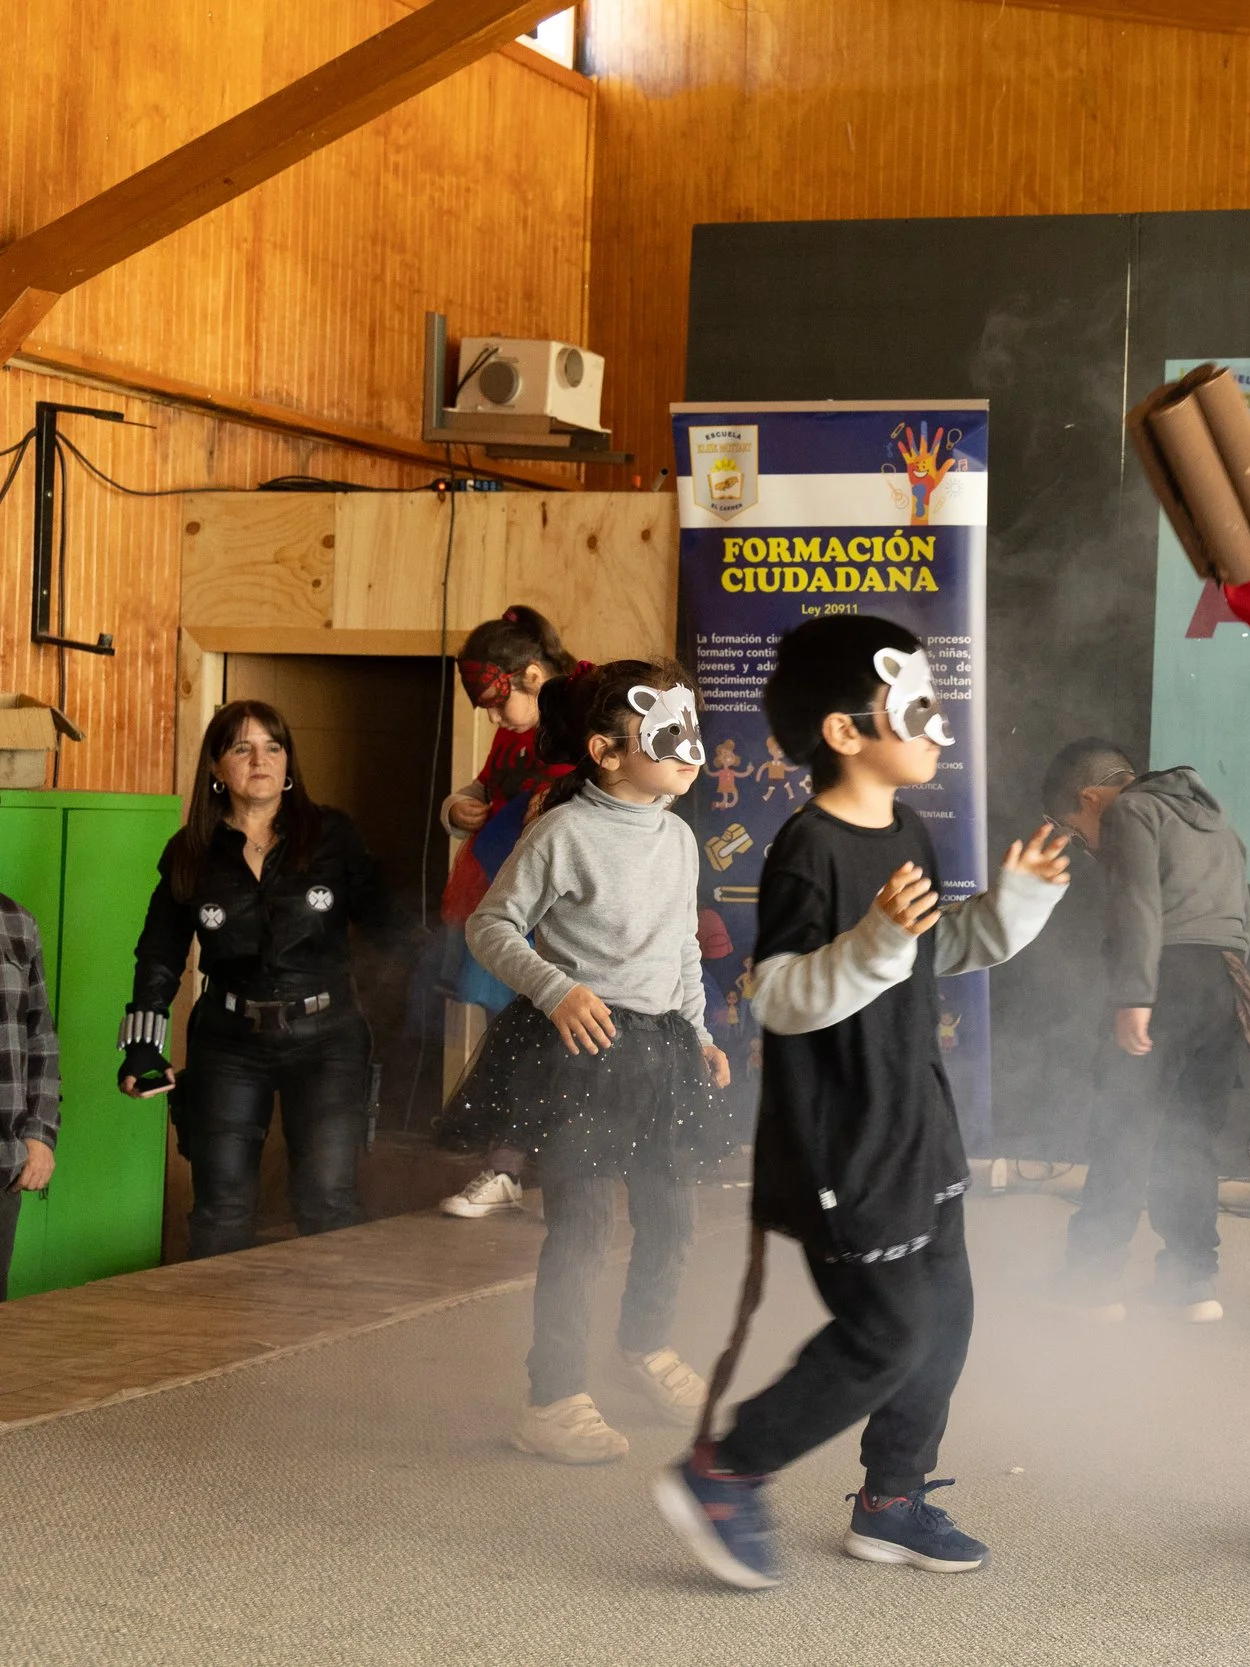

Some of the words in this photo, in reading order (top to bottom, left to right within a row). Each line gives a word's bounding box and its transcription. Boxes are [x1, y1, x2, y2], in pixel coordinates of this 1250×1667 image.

[705, 431, 742, 440] ESCUELA
[723, 529, 936, 563] FORMACIÓN
[721, 566, 939, 592] CIUDADANA
[801, 604, 821, 616] Ley
[824, 604, 858, 614] 20911
[697, 633, 707, 644] La
[711, 632, 762, 644] formación
[927, 636, 972, 646] proceso
[697, 646, 744, 657] formativo
[940, 648, 971, 659] niñas,
[697, 661, 736, 673] jóvenes
[743, 663, 749, 673] y
[956, 662, 972, 672] de
[699, 675, 768, 685] conocimientos
[931, 675, 971, 686] esultan
